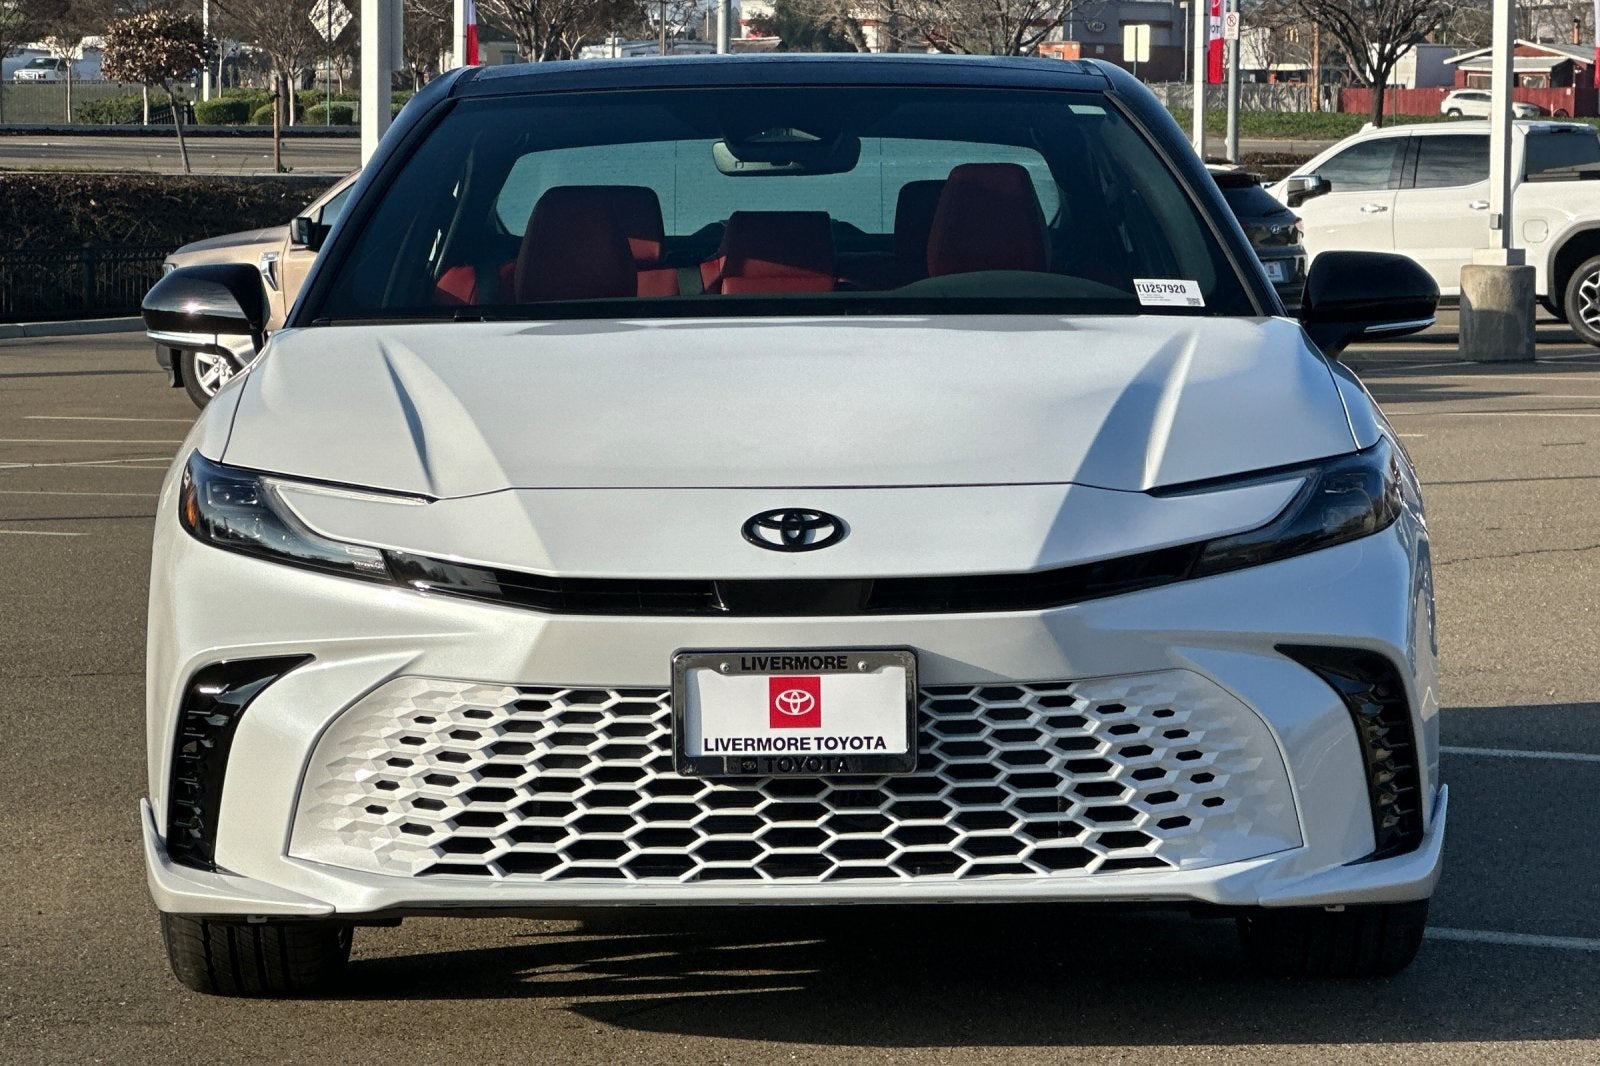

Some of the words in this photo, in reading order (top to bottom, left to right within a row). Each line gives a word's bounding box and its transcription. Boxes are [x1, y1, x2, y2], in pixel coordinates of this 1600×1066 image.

[1136, 284, 1186, 294] TU257920
[741, 656, 848, 671] LIVERMORE
[704, 737, 811, 752] LIVERMORE
[813, 736, 887, 751] TOYOTA
[764, 756, 849, 773] TOYOTA
